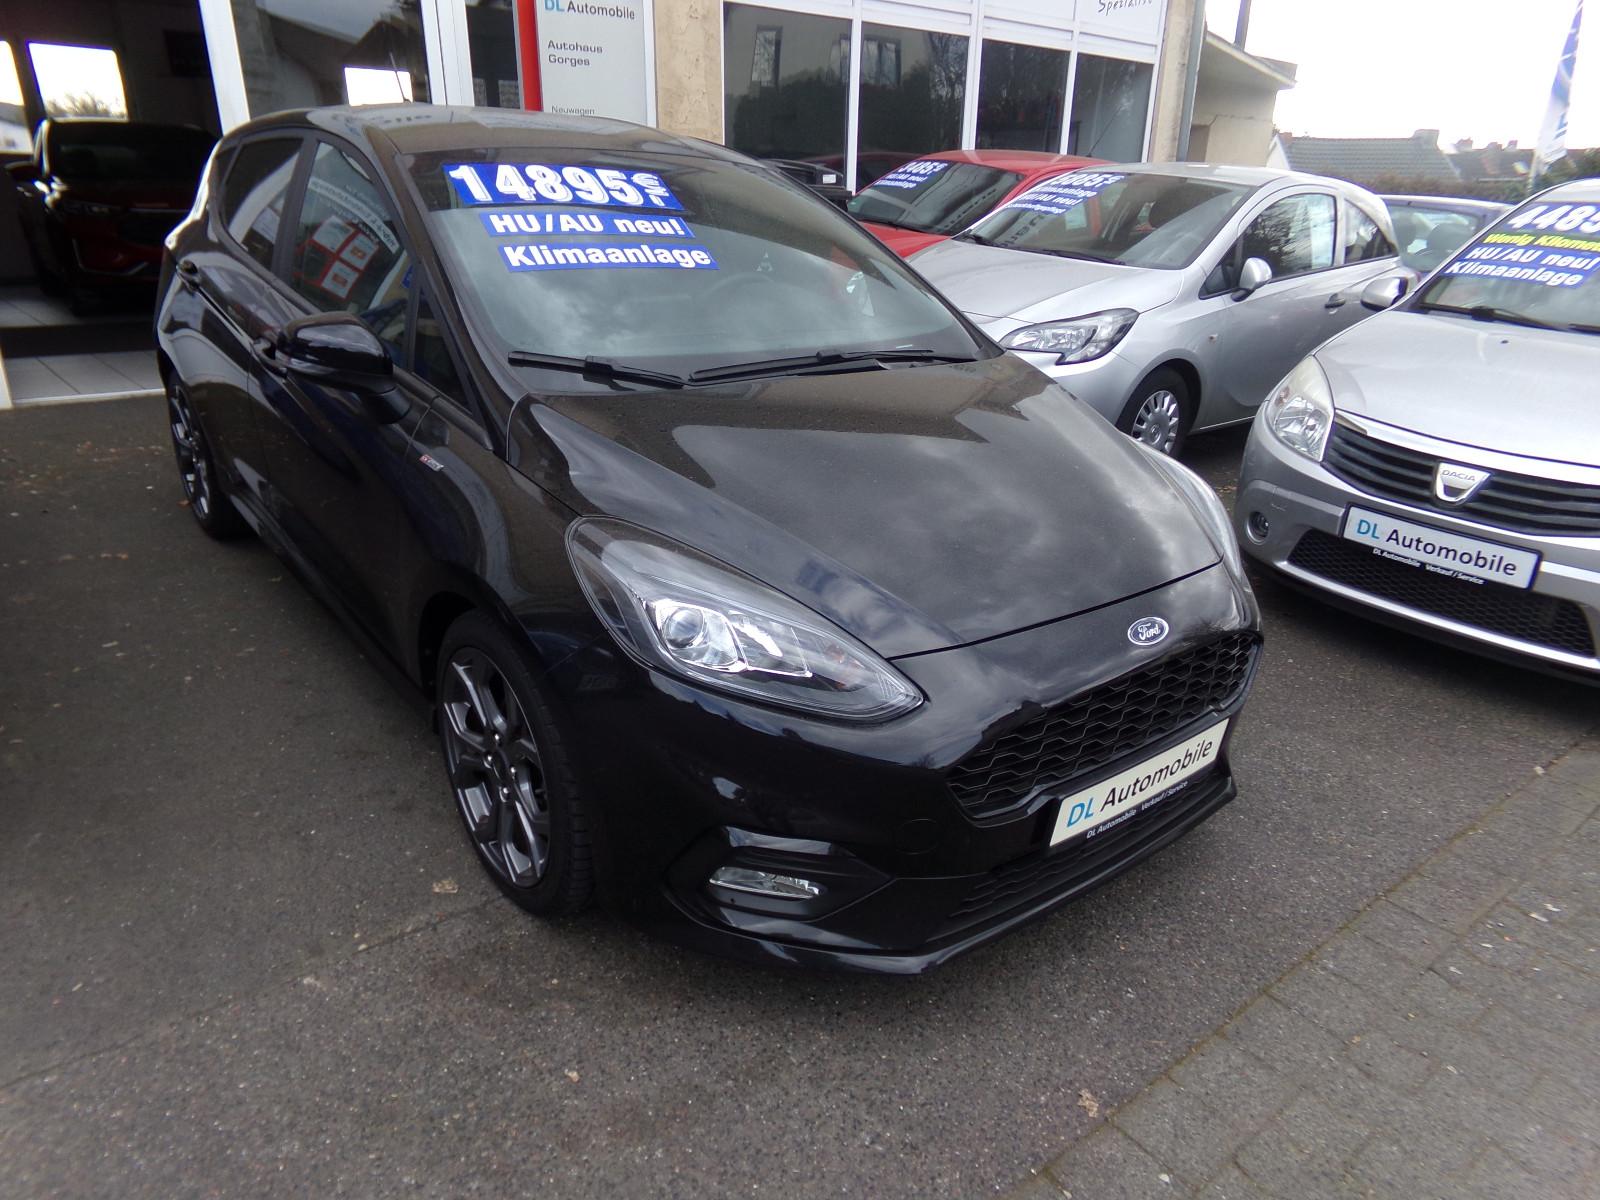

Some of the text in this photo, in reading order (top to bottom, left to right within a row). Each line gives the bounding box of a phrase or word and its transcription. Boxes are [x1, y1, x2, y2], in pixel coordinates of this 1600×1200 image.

[567, 1, 635, 20] Automobile
[548, 40, 603, 54] Autohaus
[548, 54, 590, 67] Gorges
[551, 105, 595, 118] Neuwagen
[614, 216, 685, 236] neu!
[504, 244, 711, 269] Klimaanlage
[1464, 246, 1600, 271] HU/AU neu!
[1444, 261, 1584, 286] Klimaanlage
[1441, 469, 1476, 481] DACIA
[1356, 518, 1518, 577] DL Automobile
[1137, 622, 1161, 640] Ford
[1066, 739, 1213, 829] DL Automobile
